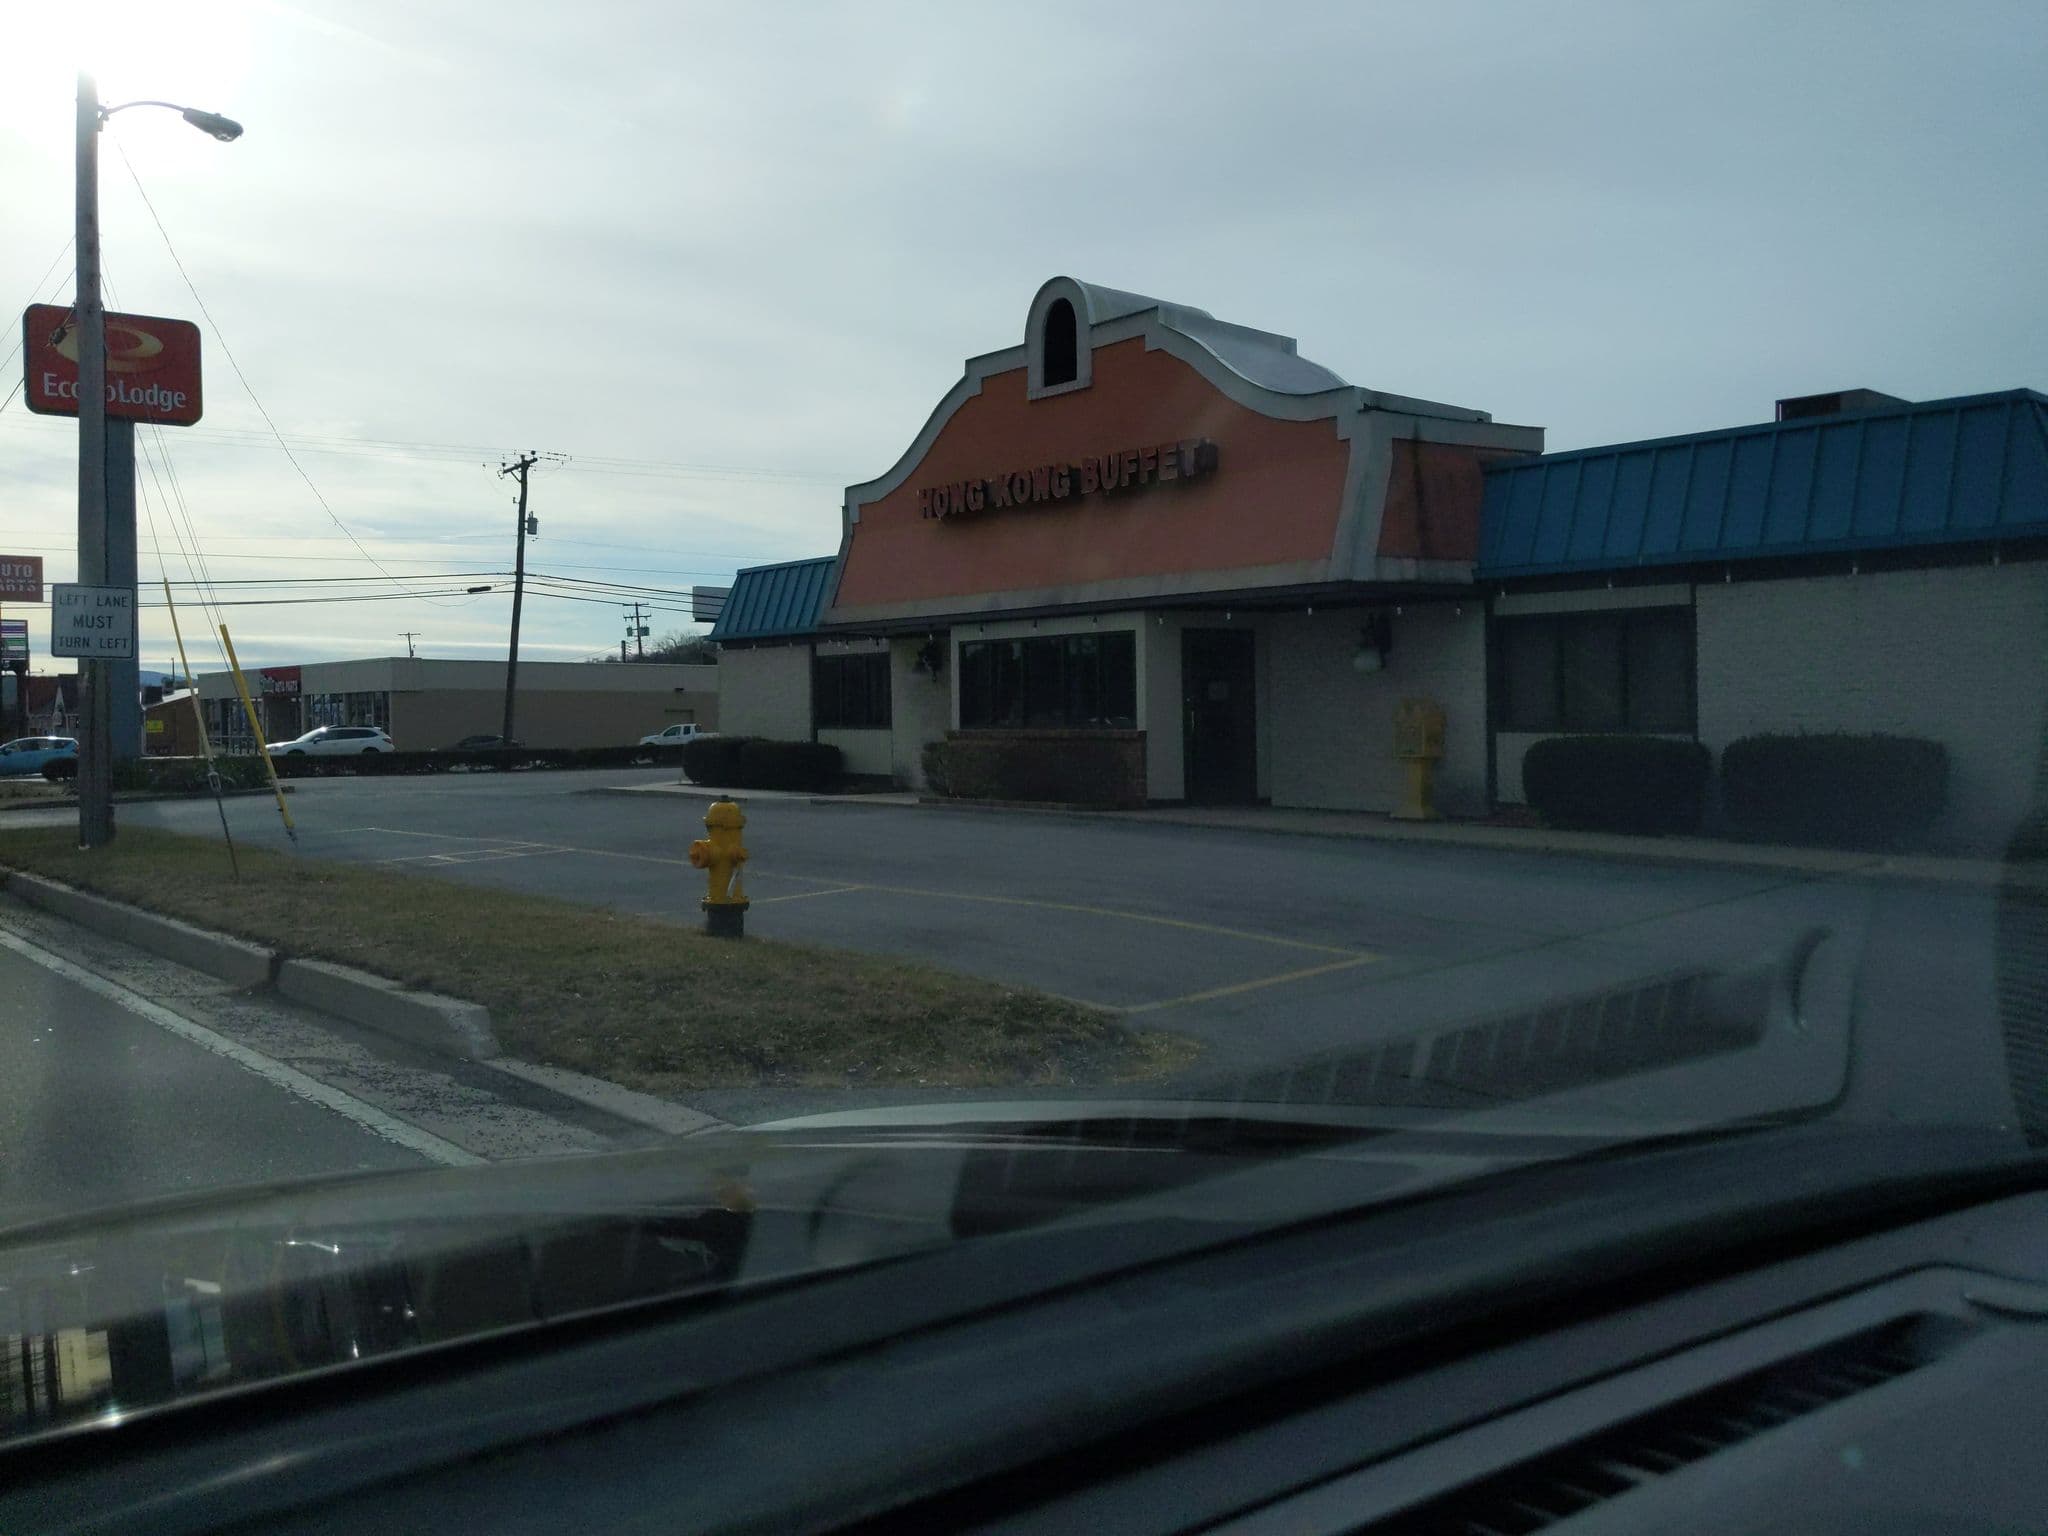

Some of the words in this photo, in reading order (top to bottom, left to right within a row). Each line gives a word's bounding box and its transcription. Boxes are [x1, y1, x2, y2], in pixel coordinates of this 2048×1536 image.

[917, 479, 985, 519] HONG
[989, 463, 1071, 508] KONG
[1080, 439, 1210, 496] BUFFET
[59, 594, 88, 606] LEFT
[96, 595, 129, 608] LANE
[73, 613, 114, 629] MUST
[59, 635, 90, 648] TURN
[99, 638, 129, 649] LEFT
